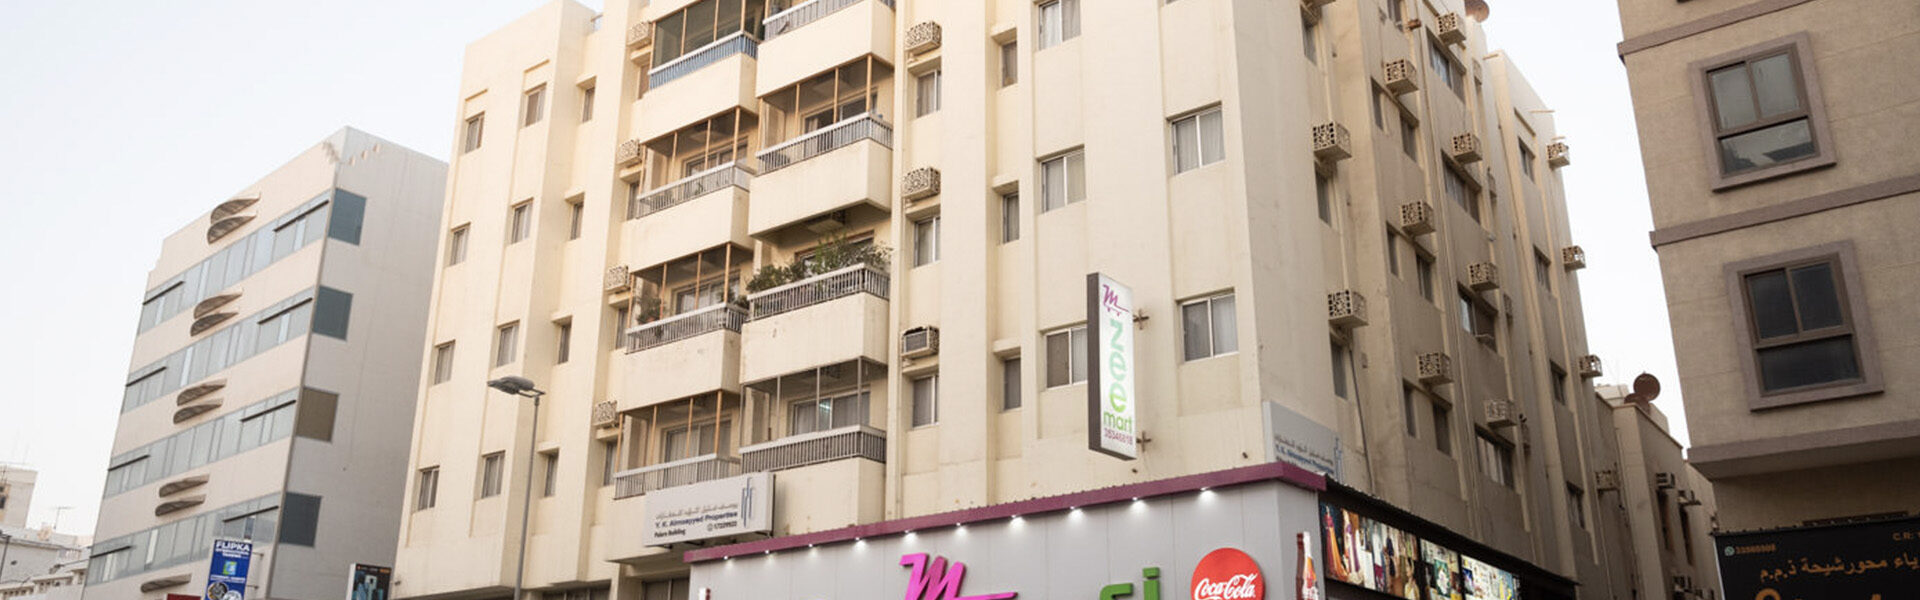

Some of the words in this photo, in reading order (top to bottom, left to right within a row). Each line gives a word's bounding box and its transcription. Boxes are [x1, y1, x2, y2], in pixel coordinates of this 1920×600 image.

[1103, 411, 1132, 434] mart
[705, 511, 738, 522] Properties
[216, 541, 250, 551] FLIPKA
[1194, 573, 1258, 600] Coca-Cola
